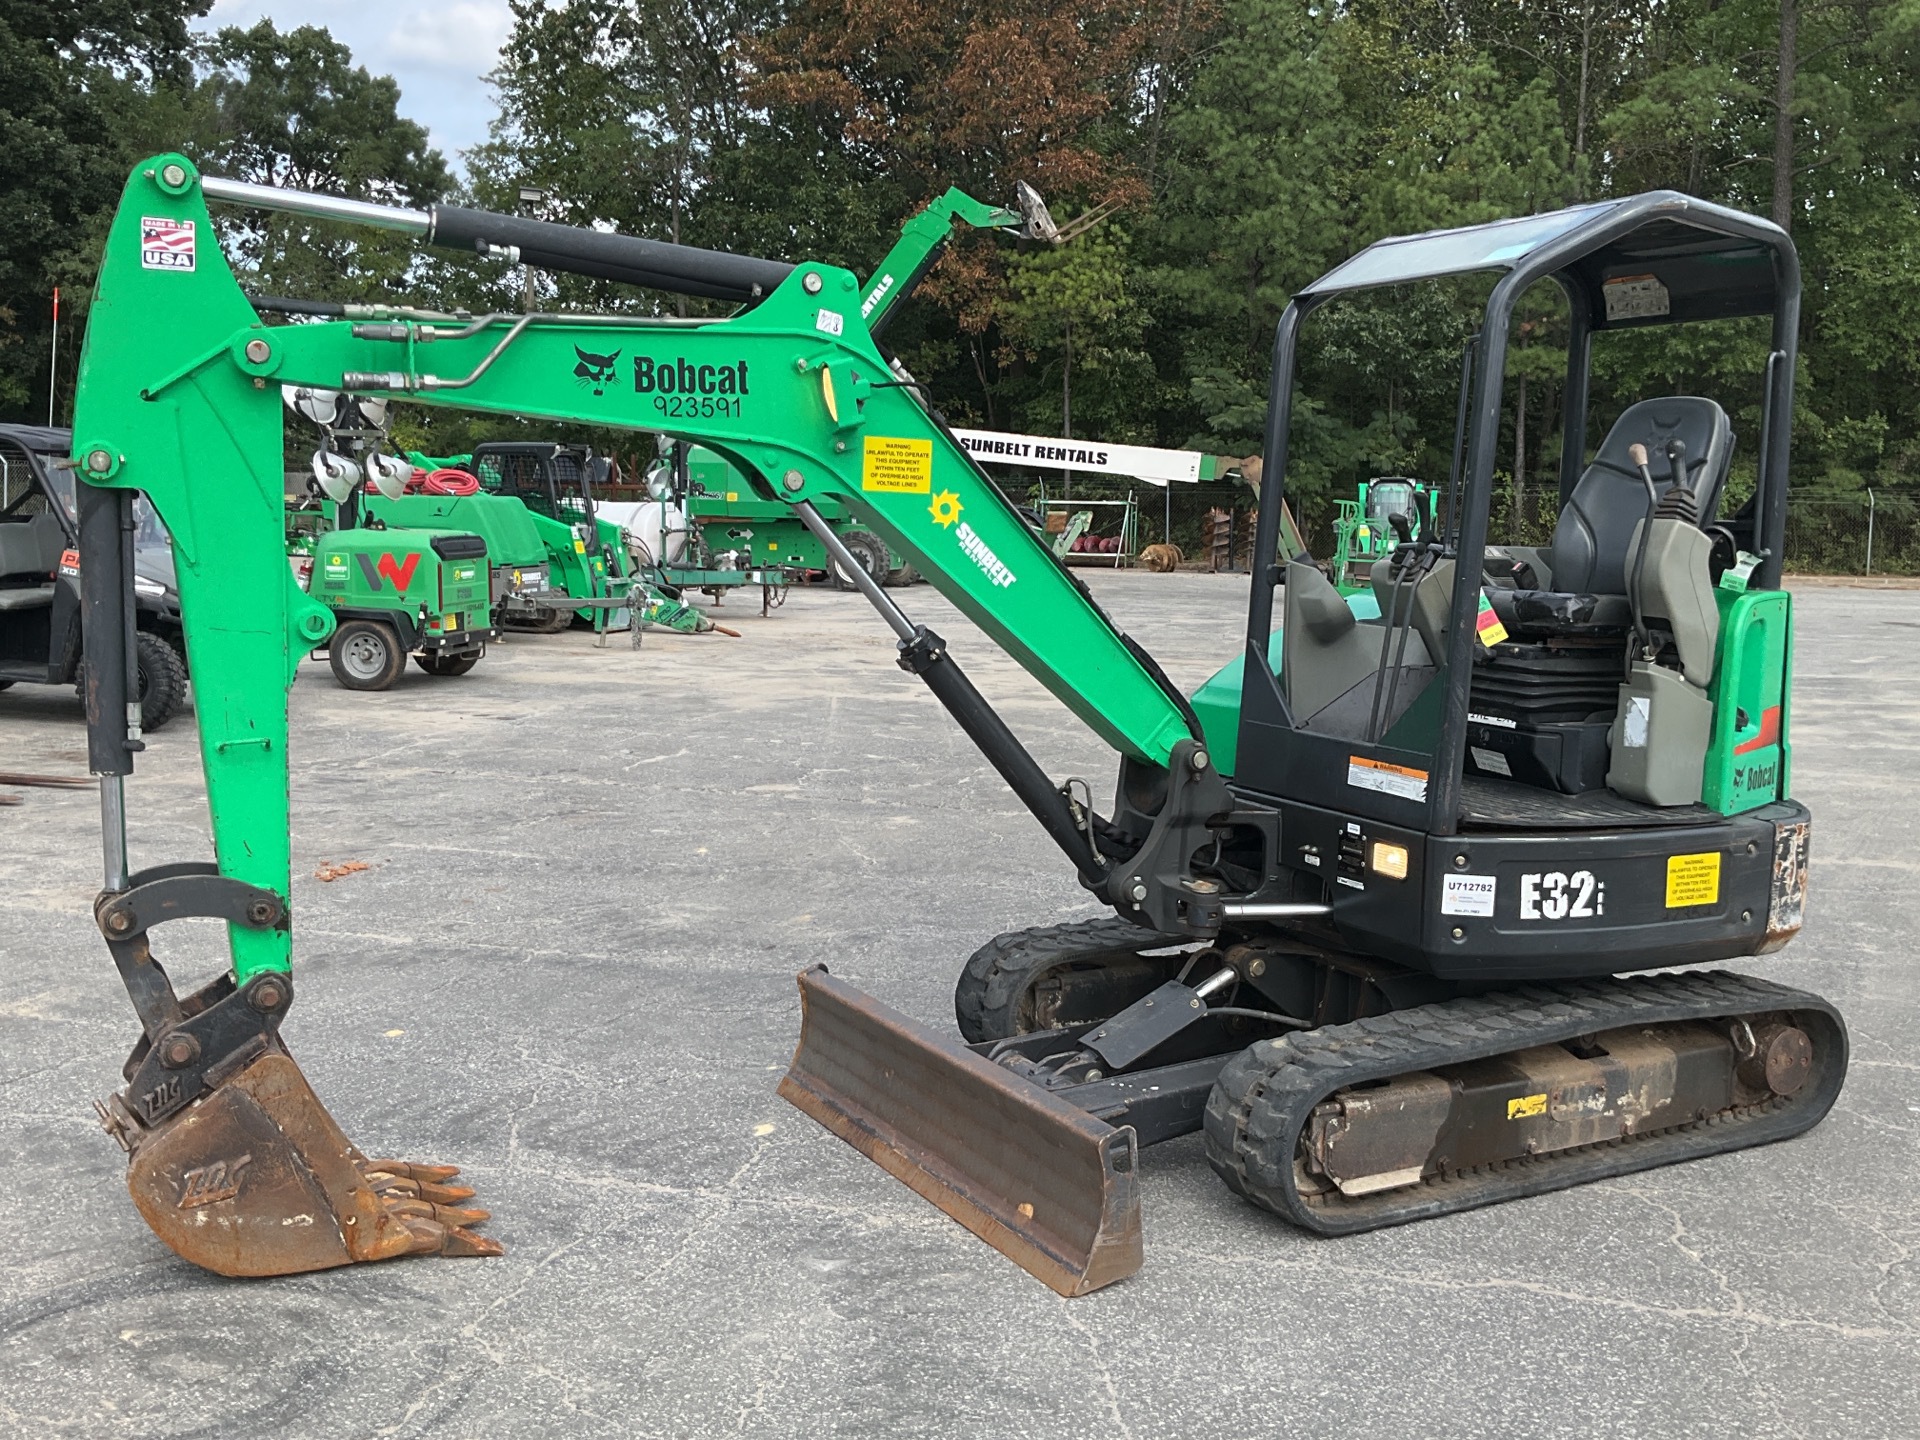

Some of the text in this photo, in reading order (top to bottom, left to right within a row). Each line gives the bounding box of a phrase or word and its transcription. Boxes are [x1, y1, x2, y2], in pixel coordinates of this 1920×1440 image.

[146, 252, 191, 266] USA
[862, 273, 893, 319] ENTALS
[634, 356, 749, 395] Bobcat
[654, 396, 741, 418] 923591
[960, 438, 1108, 465] SUNBELT RENTALS
[956, 522, 1017, 588] SUNBELT
[1380, 764, 1402, 773] WARNING
[1747, 762, 1775, 792] Bobcat
[1449, 882, 1492, 892] U712782
[1520, 870, 1604, 920] E32i
